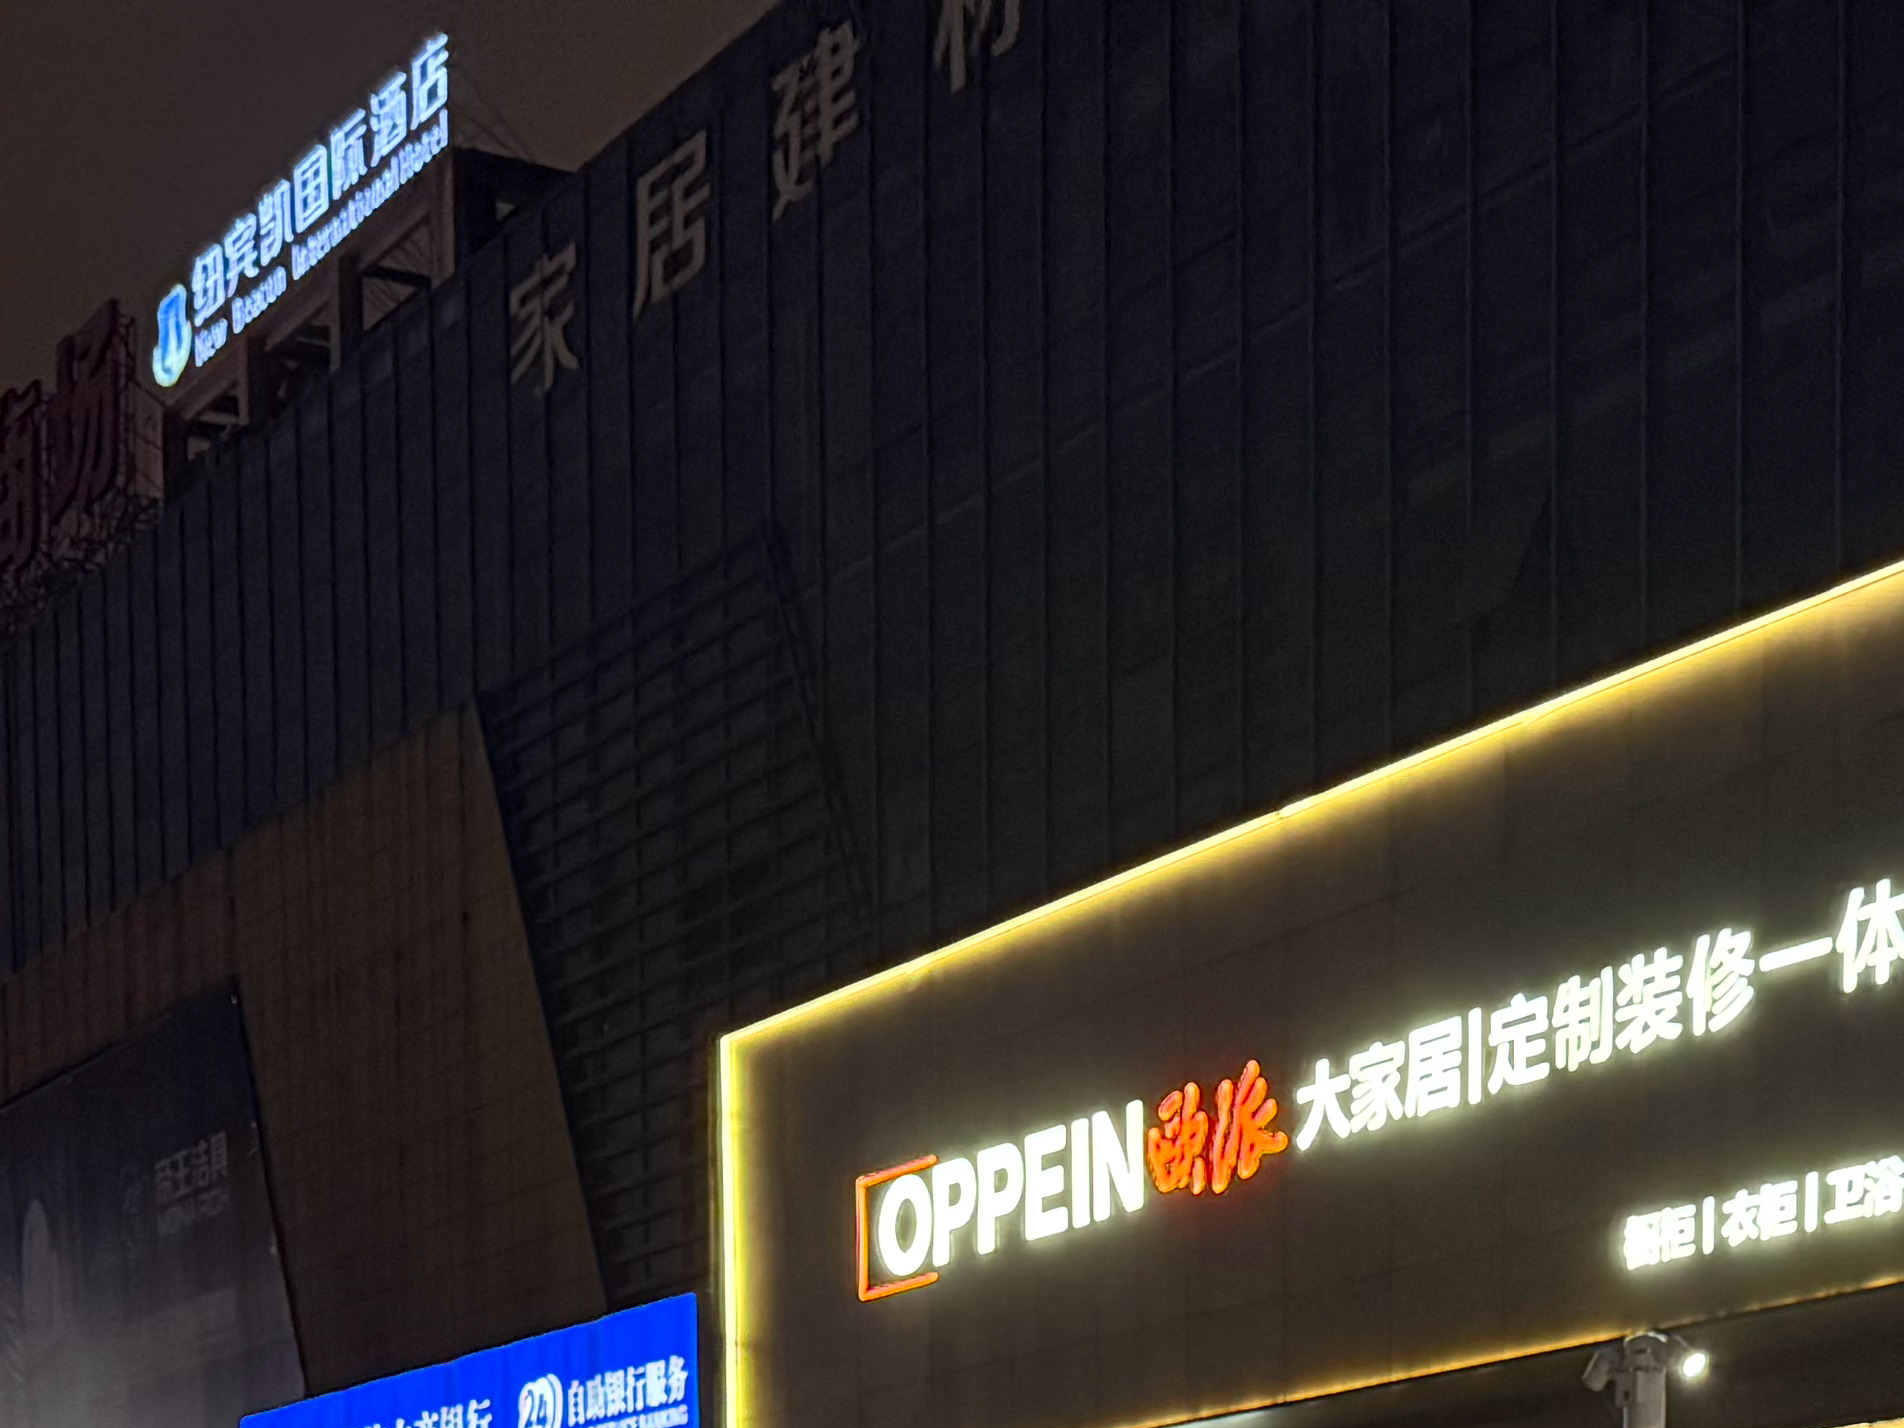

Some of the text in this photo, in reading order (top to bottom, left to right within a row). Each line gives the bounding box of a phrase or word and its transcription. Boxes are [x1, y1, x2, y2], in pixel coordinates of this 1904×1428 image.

[1296, 1010, 1462, 1152] 大家居
[879, 1099, 1145, 1274] OPPEIN
[567, 1355, 689, 1428] 自助银行服务
